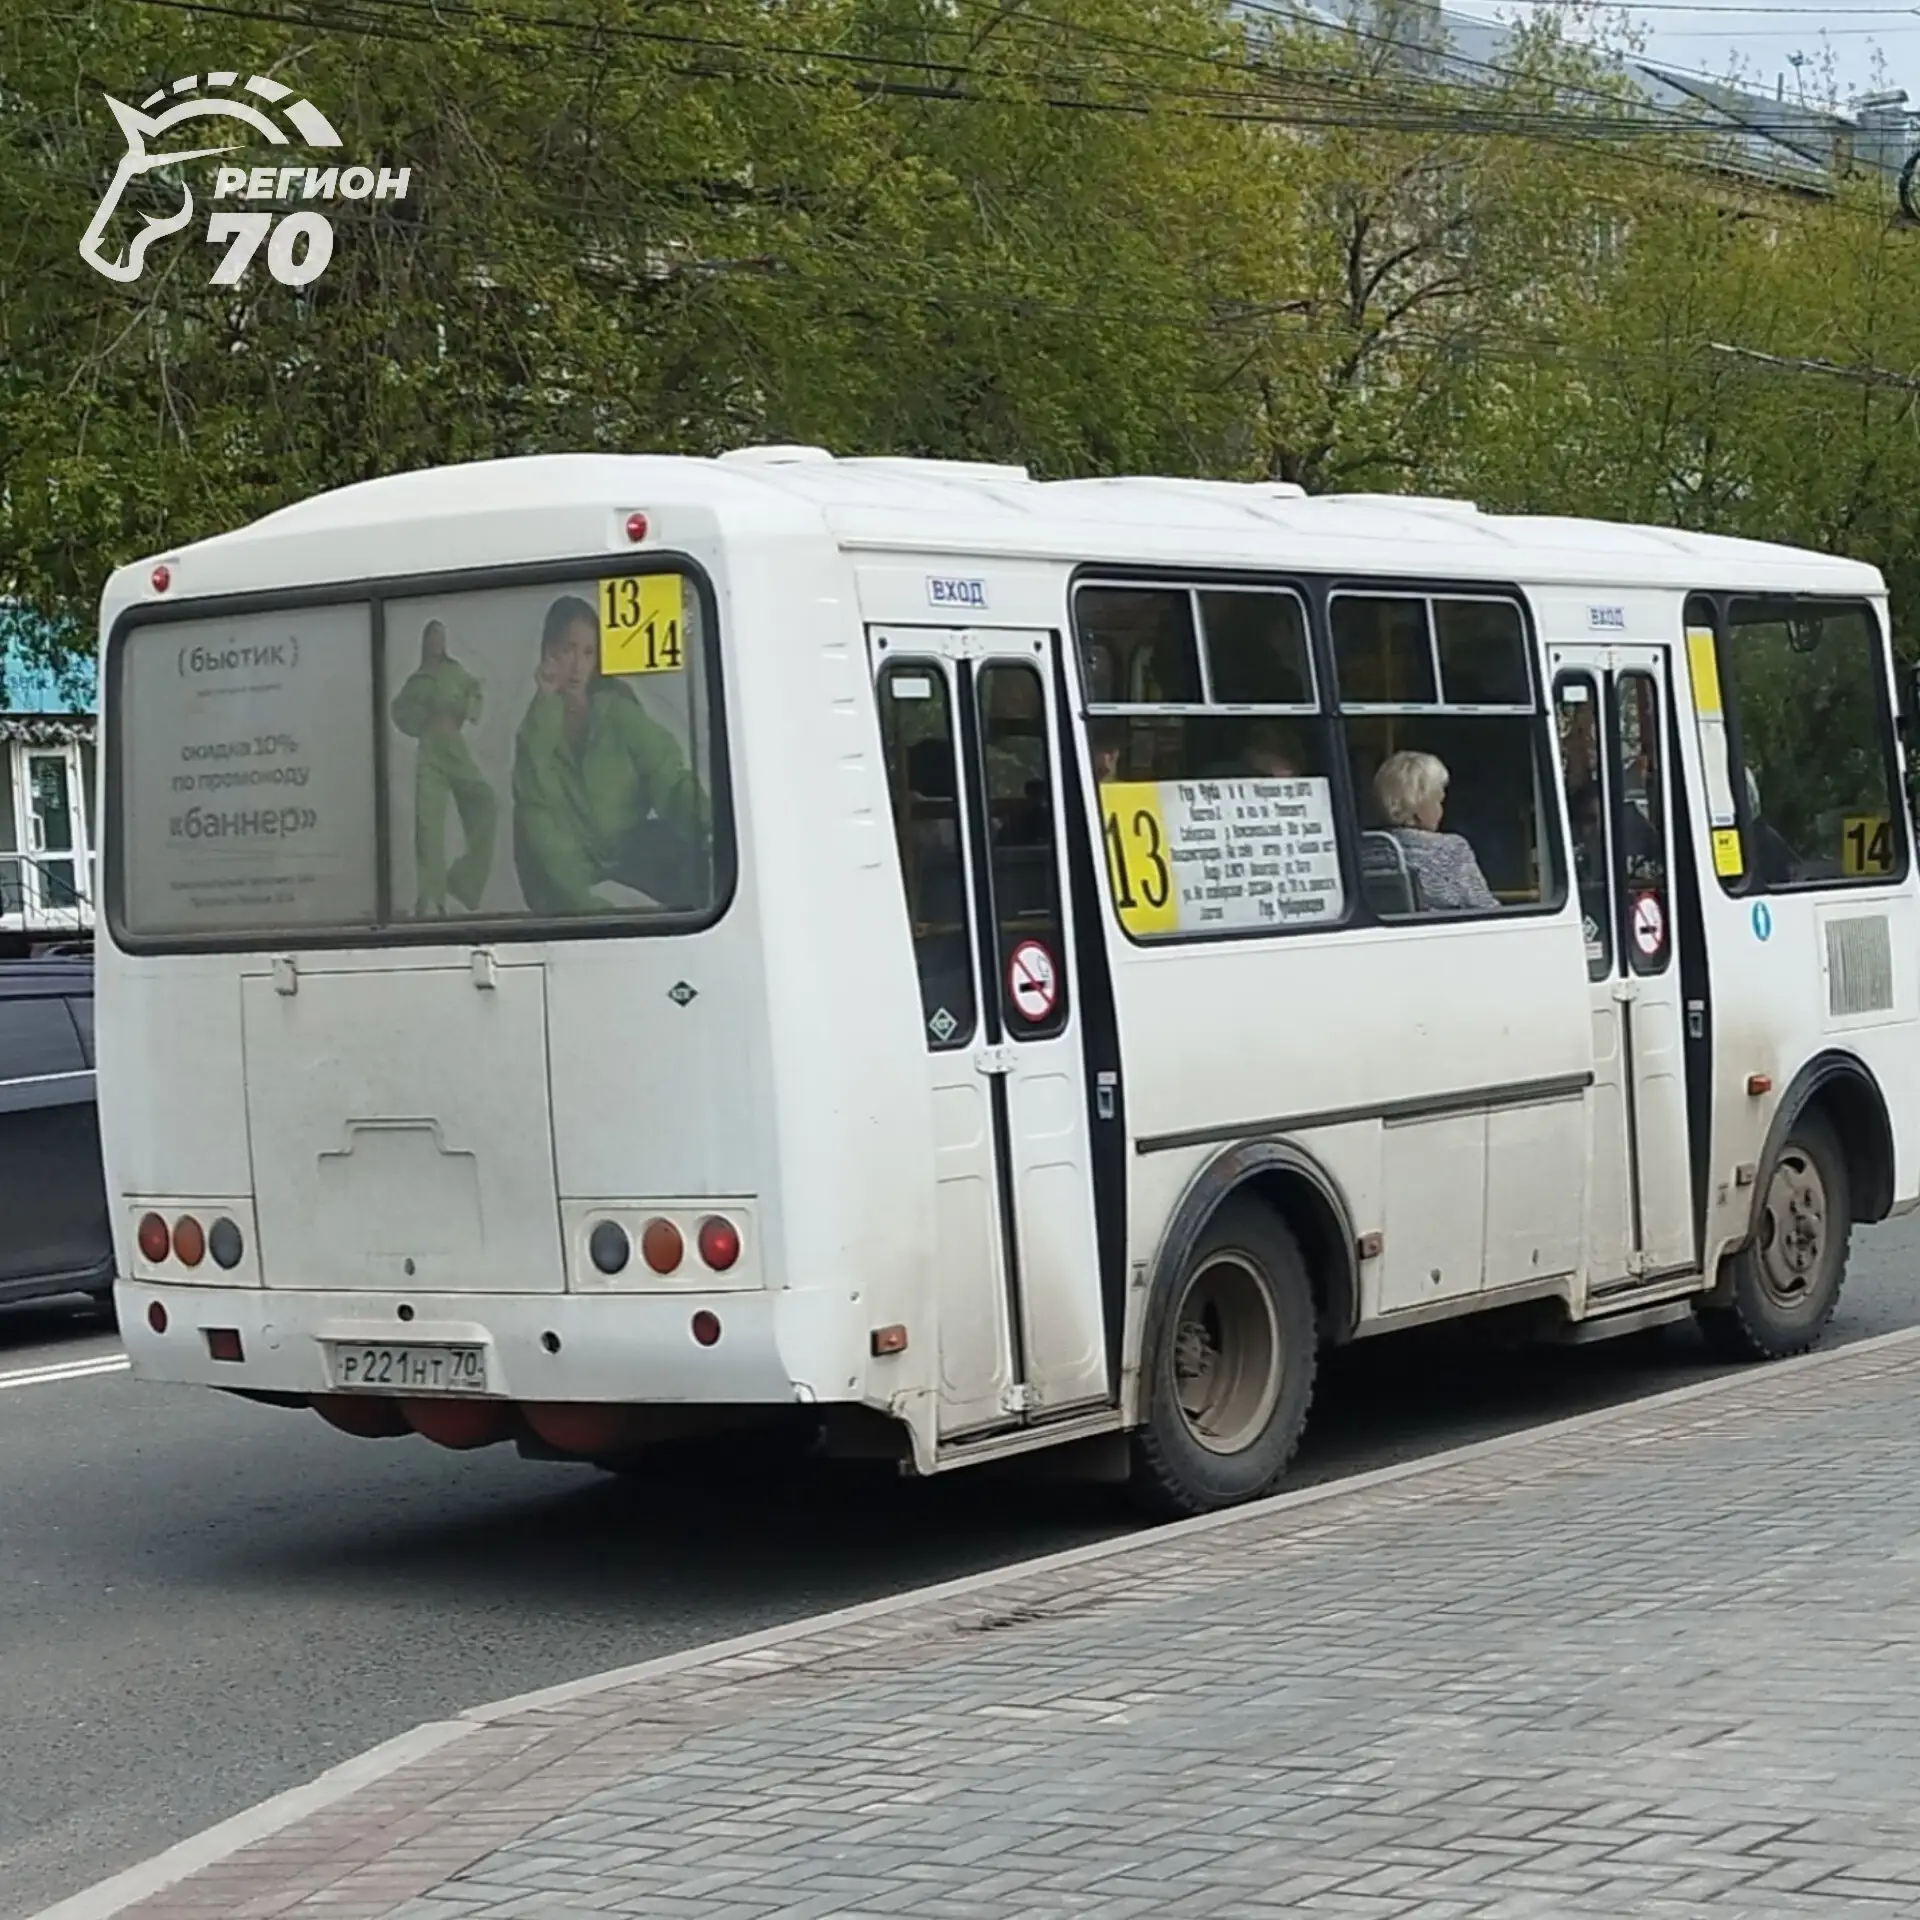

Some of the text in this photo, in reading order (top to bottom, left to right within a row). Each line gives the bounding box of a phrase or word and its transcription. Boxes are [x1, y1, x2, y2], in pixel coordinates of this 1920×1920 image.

[932, 580, 985, 605] ВХОД
[253, 734, 298, 756] 10%
[172, 766, 310, 793] по промокоду
[169, 806, 318, 838] «баннер»
[1104, 809, 1169, 909] 13
[1847, 822, 1893, 871] 14
